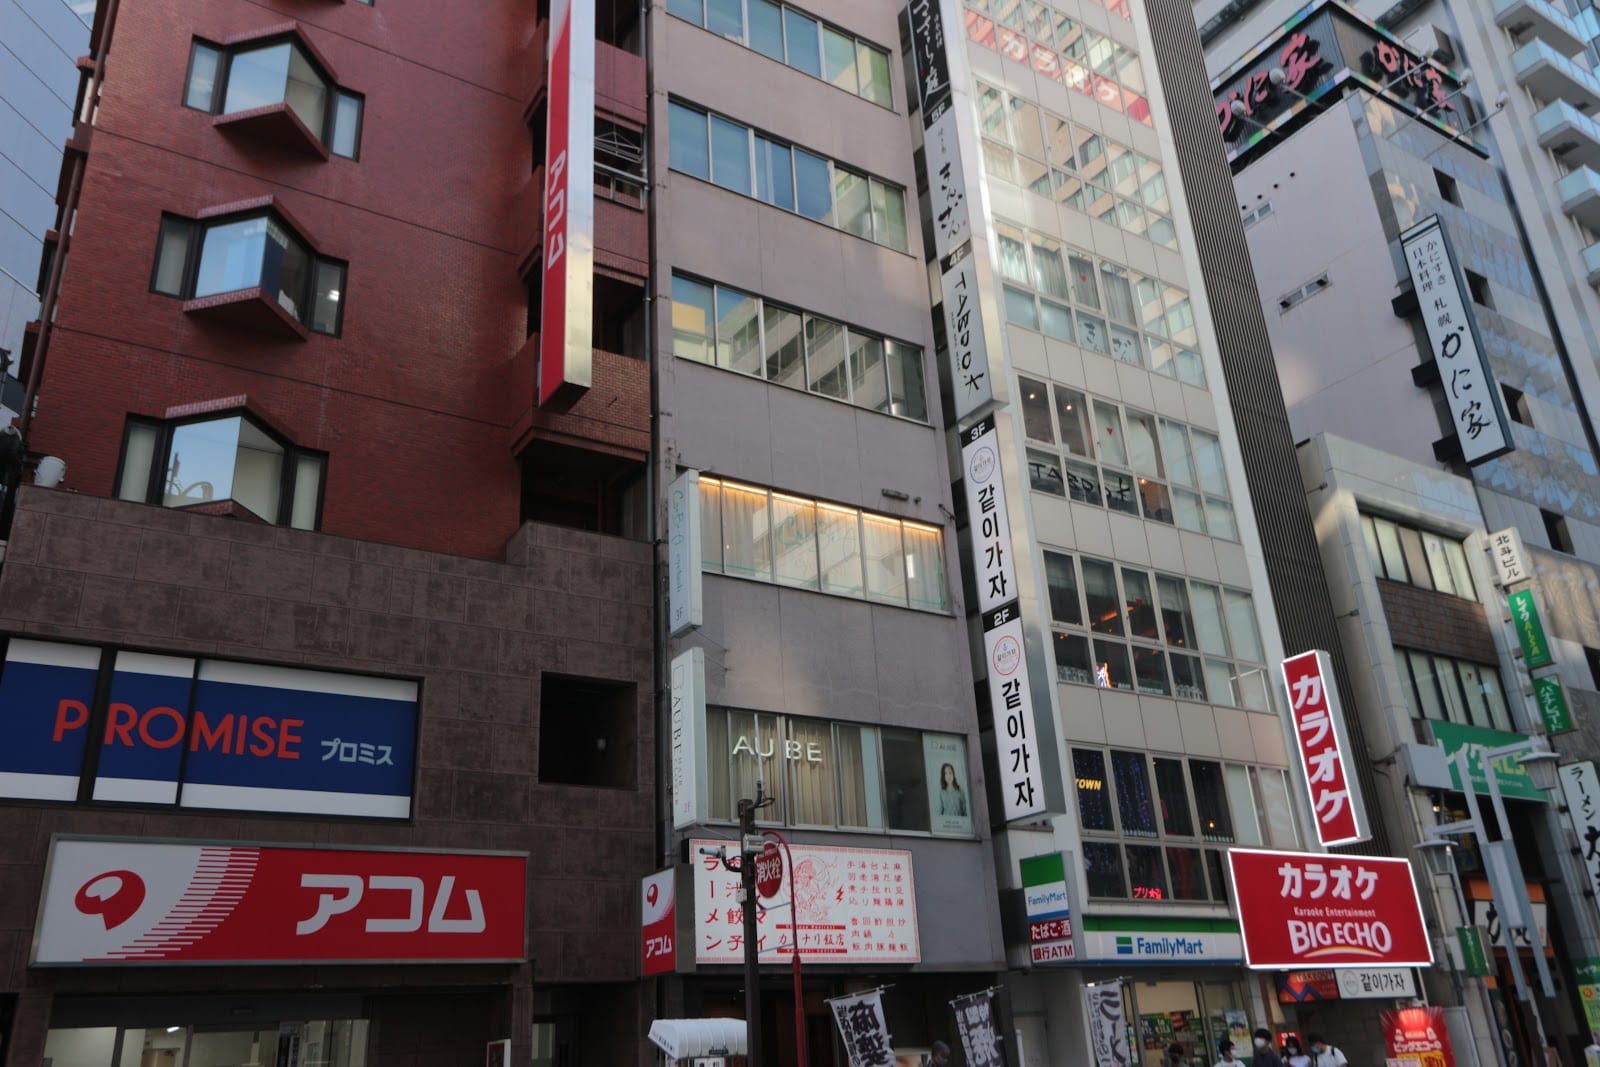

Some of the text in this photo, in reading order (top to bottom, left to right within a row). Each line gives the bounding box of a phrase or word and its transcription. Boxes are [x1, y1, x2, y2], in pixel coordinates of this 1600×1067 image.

[548, 149, 566, 270] アコム
[949, 250, 965, 267] 4F
[1413, 249, 1433, 293] 日本料理
[1433, 299, 1452, 328] 札幌
[1441, 325, 1492, 440] かに家
[970, 422, 985, 441] 3F
[978, 483, 1007, 599] 같이가자
[993, 608, 1010, 627] 2F
[52, 699, 304, 760] PROMISE
[1002, 678, 1035, 808] 같이가자
[320, 737, 395, 767] プロミス
[732, 735, 823, 763] AUBE
[1292, 675, 1349, 823] カラオケ
[1571, 766, 1595, 821] ラーメン
[756, 859, 781, 883] 消火栓
[1277, 862, 1378, 900] カラオケ
[296, 873, 487, 936] アコム
[703, 856, 722, 952] ラーメン
[1028, 891, 1067, 906] FamilyMart
[1293, 906, 1376, 918] Karaoke Entertainment
[646, 935, 672, 959] アコム
[779, 932, 845, 946] カナリ飯店
[1136, 937, 1203, 956] FamilyMart
[1287, 919, 1392, 954] BIG ECHO
[1360, 973, 1405, 992] 같이가자
[1576, 965, 1600, 975] レイク
